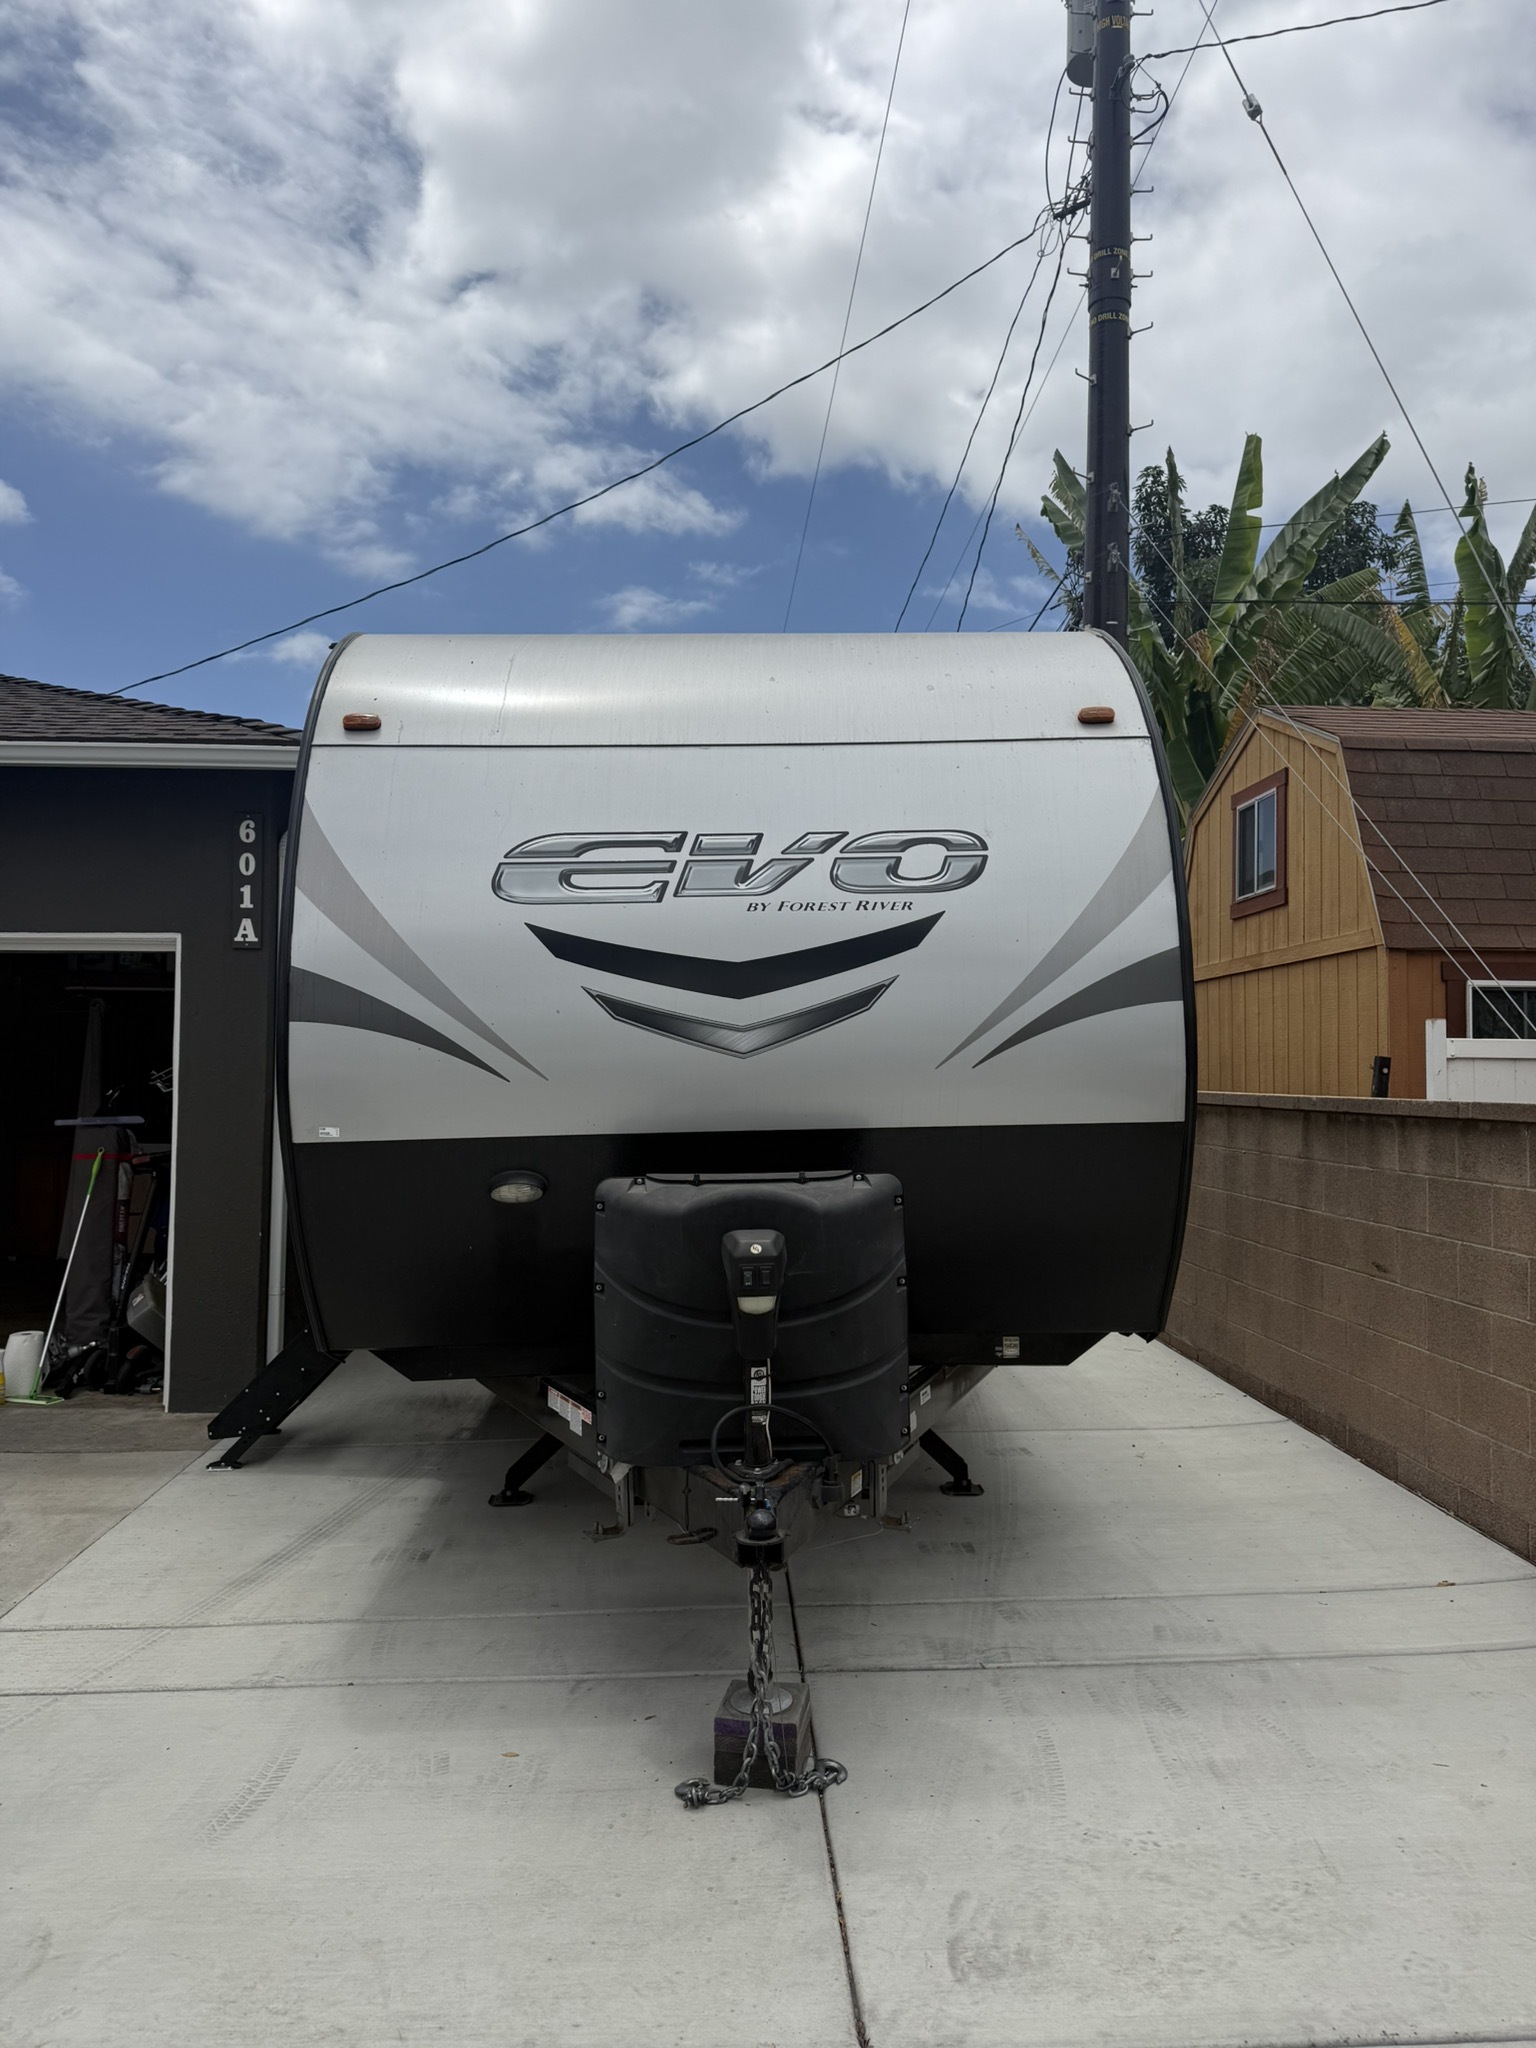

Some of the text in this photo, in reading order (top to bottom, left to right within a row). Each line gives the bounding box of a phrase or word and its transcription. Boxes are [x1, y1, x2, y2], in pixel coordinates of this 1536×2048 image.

[1094, 247, 1112, 260] DRILL
[1113, 247, 1129, 258] ZONE
[1097, 312, 1117, 322] DRILL
[1118, 312, 1129, 323] ZON
[491, 829, 989, 905] EVO
[234, 819, 258, 942] 601A
[746, 900, 914, 912] BY FOREST RIVER
